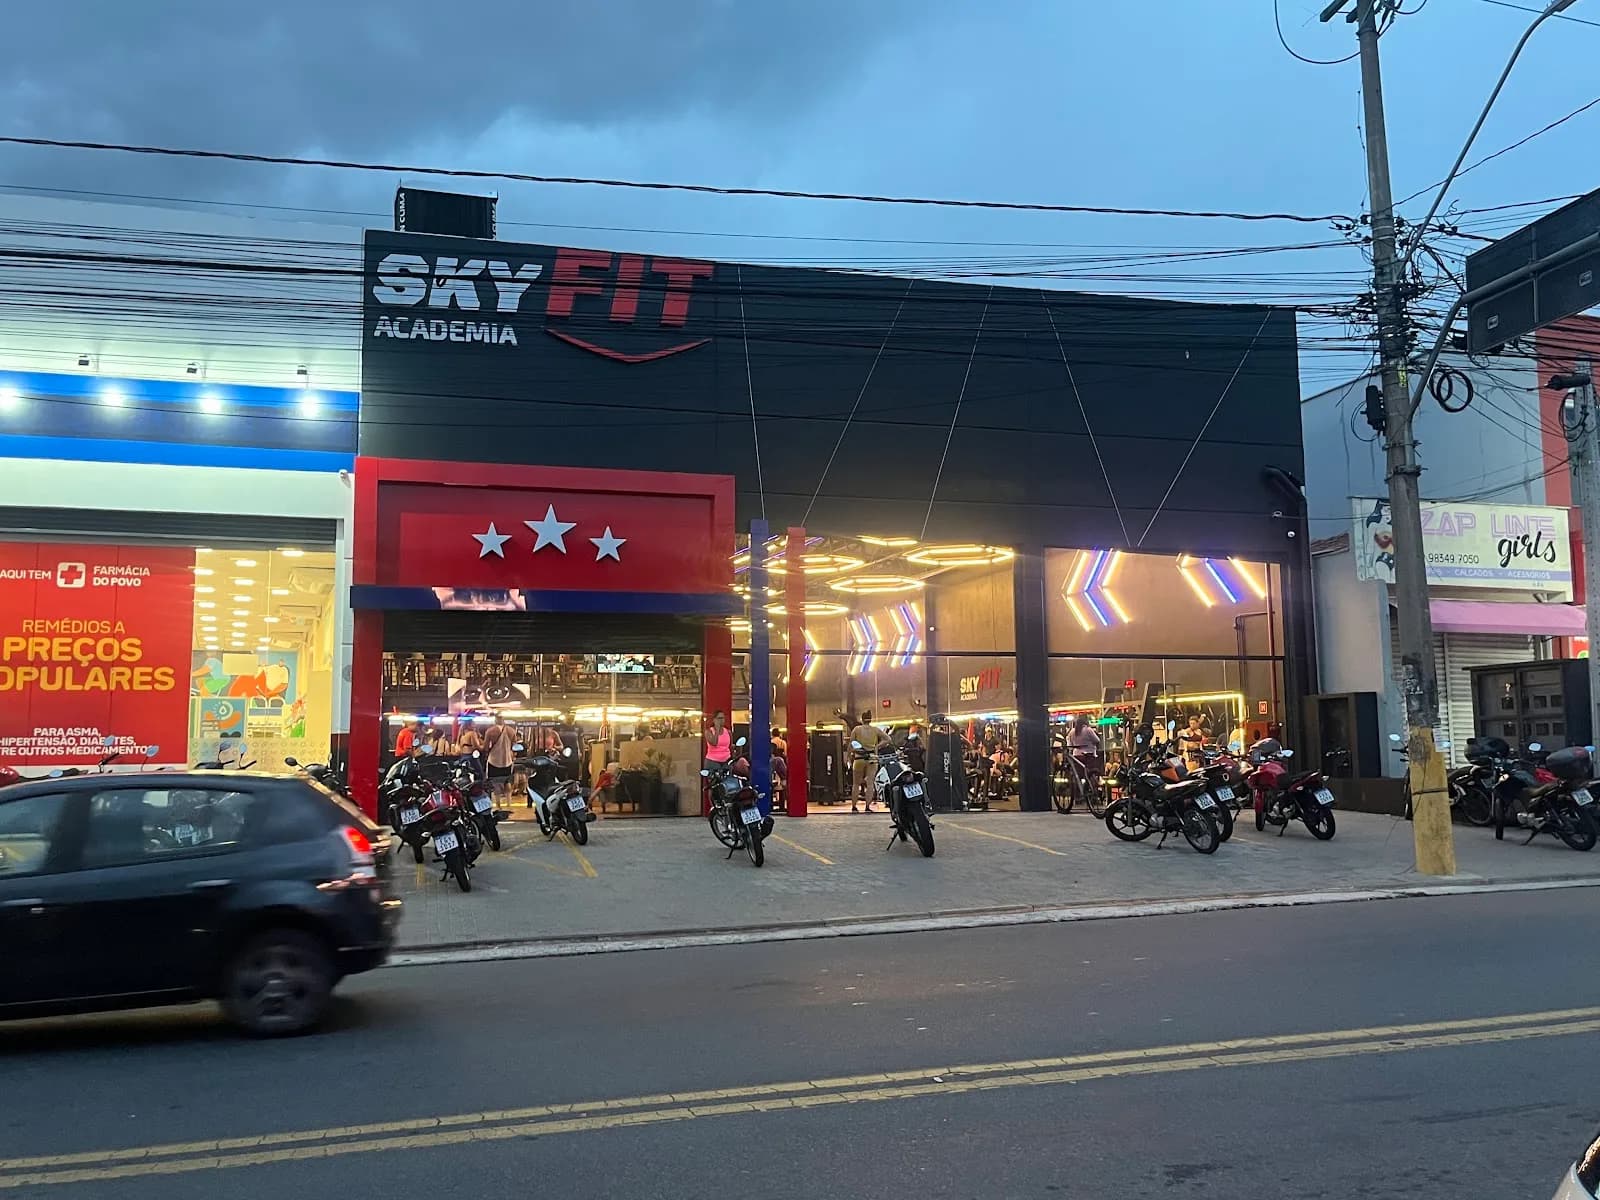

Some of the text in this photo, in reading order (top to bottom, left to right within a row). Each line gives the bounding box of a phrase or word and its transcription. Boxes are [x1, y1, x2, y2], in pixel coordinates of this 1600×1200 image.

[373, 315, 518, 347] ACADEMIA
[1421, 509, 1555, 540] ZAP LINE
[1497, 530, 1556, 568] girls
[0, 569, 52, 580] AQUI TEM
[93, 565, 151, 577] FARMÁCIA
[93, 577, 142, 587] DO POVO
[22, 618, 126, 635] REMÉDIOS A
[3, 637, 142, 666] PREÇOS
[33, 727, 102, 738] PARA ASMA,
[80, 736, 137, 747] DIABTES,
[18, 747, 64, 756] OUTROS
[66, 746, 154, 756] MEDICAMENTO
